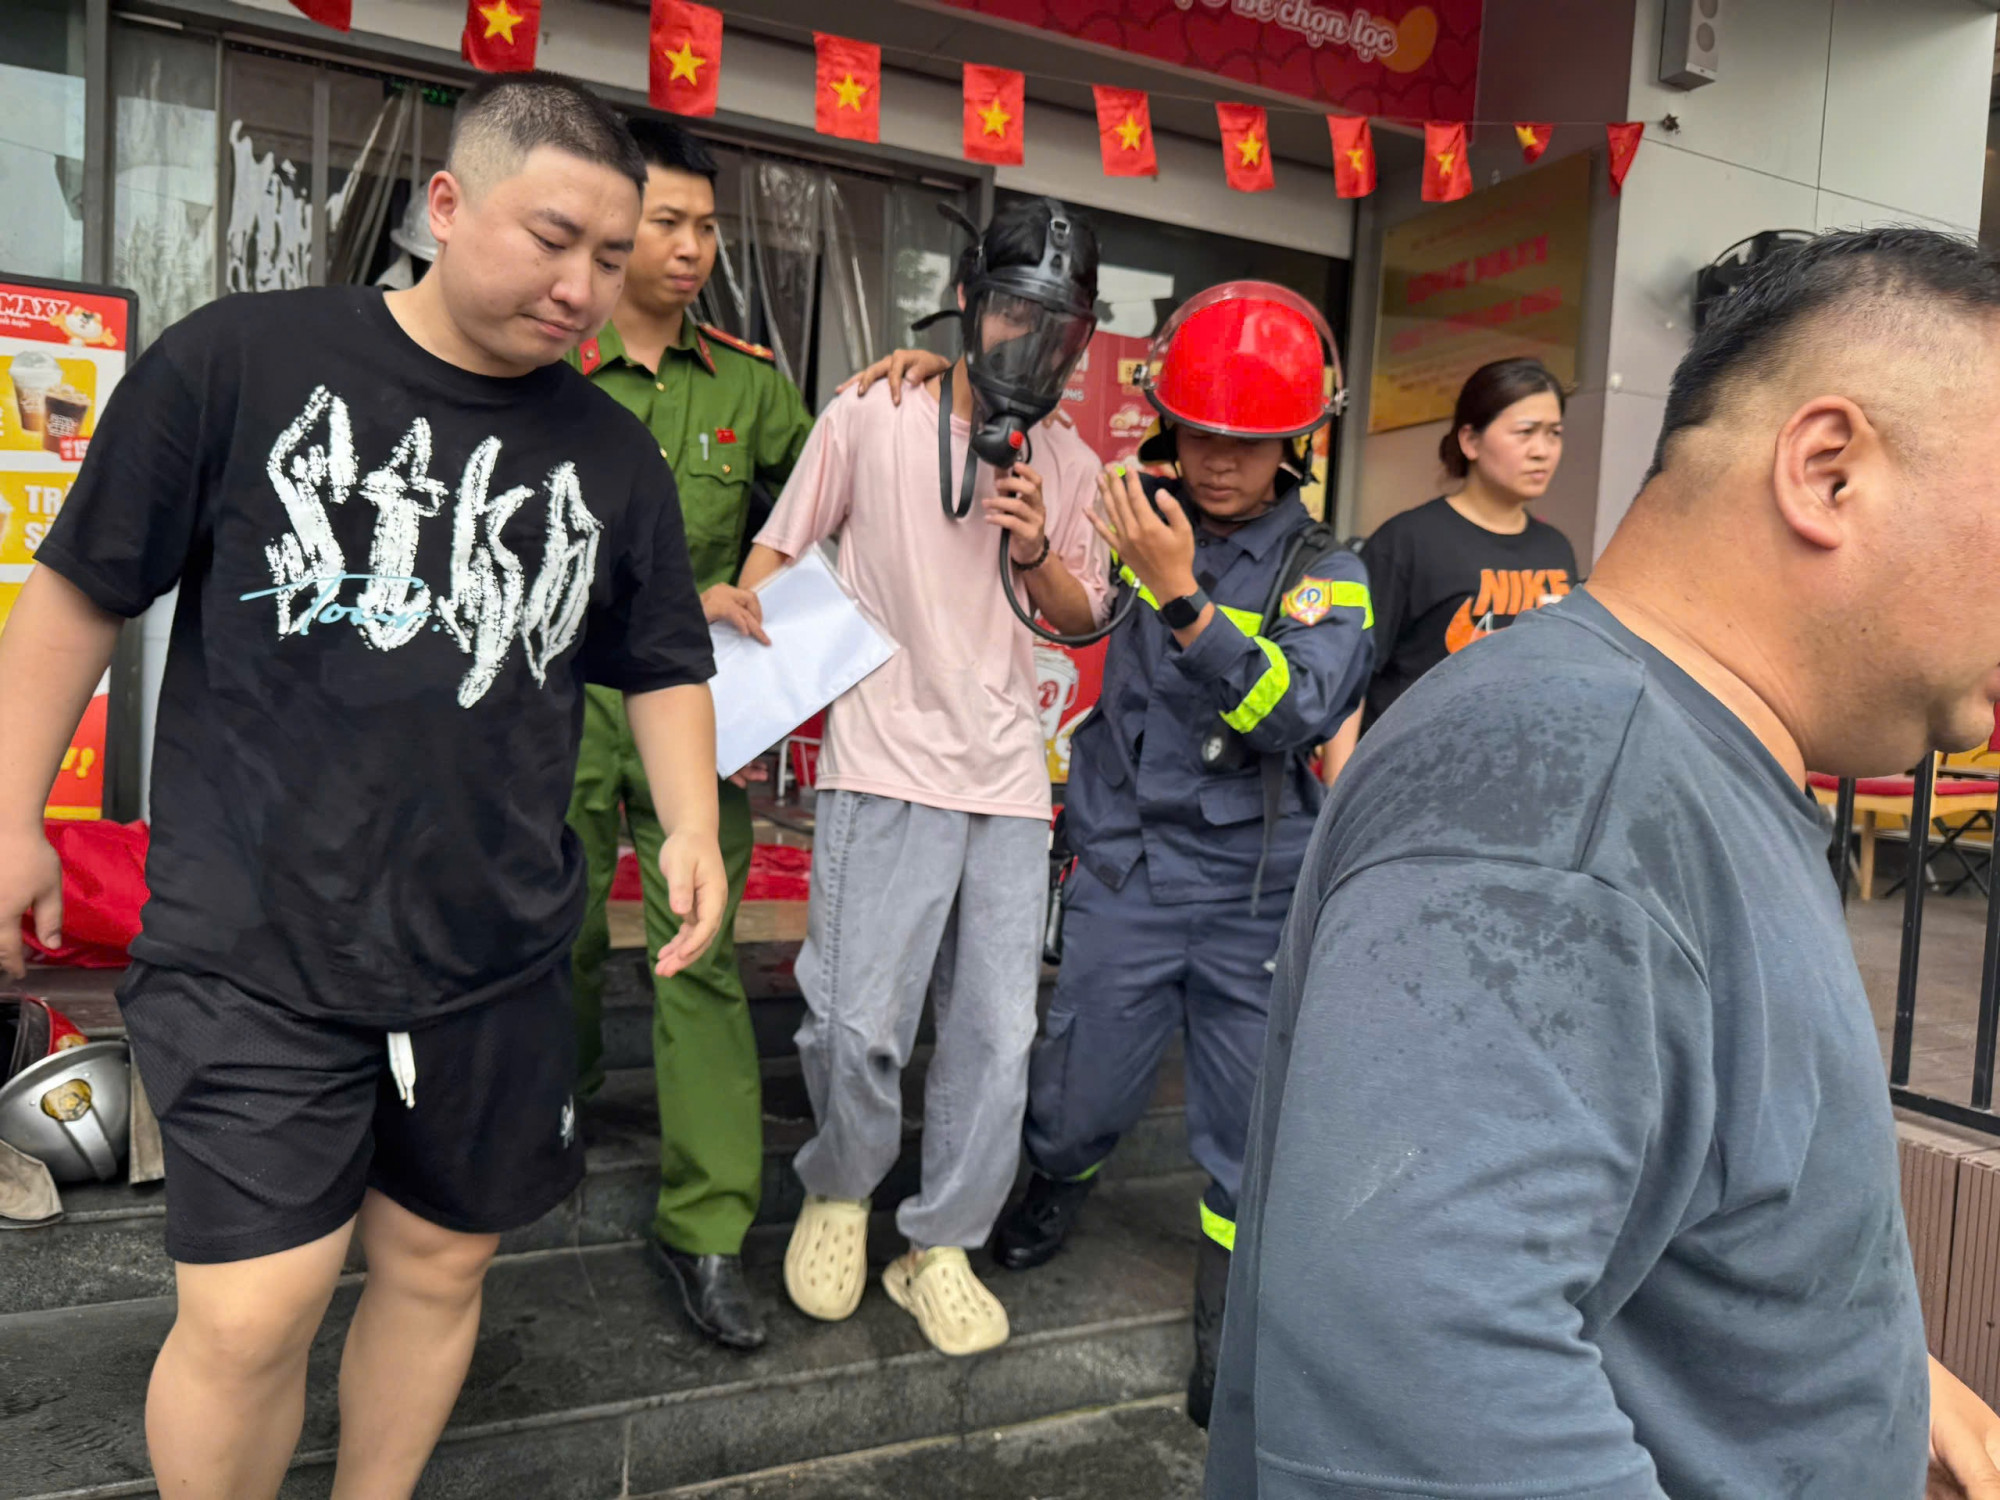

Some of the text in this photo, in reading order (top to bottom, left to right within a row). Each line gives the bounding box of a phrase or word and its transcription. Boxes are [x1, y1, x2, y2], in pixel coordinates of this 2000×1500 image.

[1352, 10, 1396, 60] lọc
[24, 482, 72, 515] TR
[1472, 568, 1570, 616] NIKE
